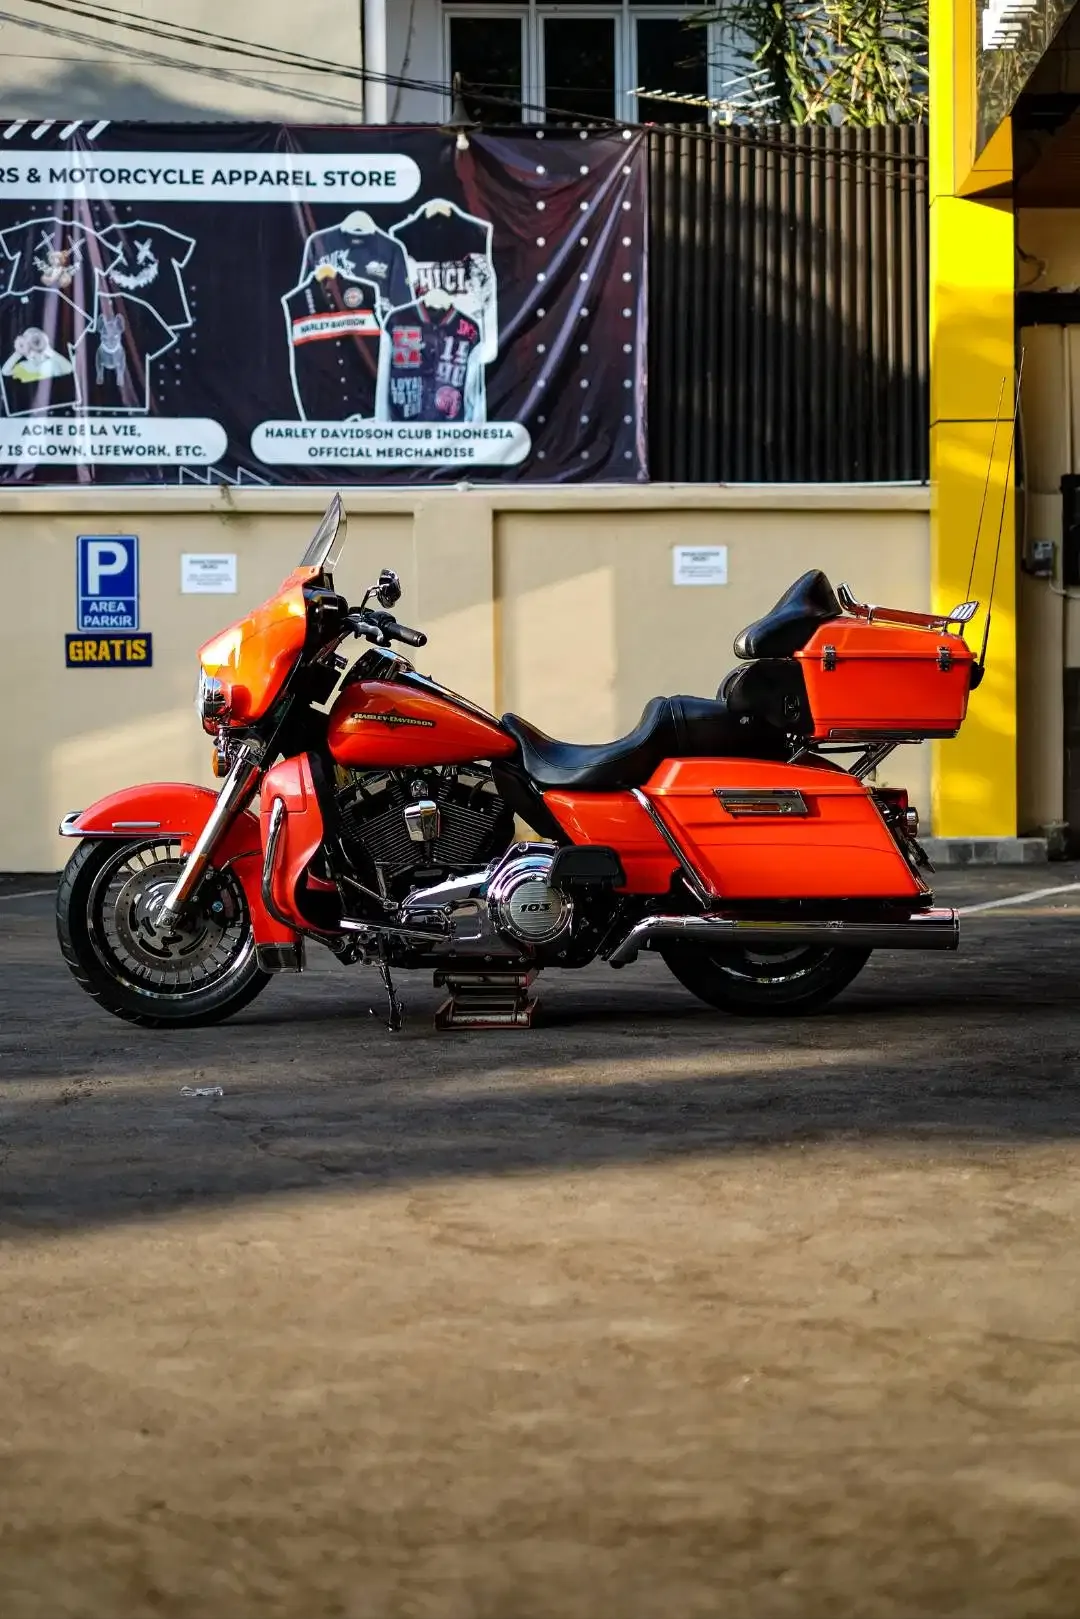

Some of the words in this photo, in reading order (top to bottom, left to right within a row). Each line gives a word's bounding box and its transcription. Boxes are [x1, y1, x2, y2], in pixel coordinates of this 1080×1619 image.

[26, 168, 41, 183] &
[49, 167, 204, 185] MOTORCYCLE
[211, 169, 317, 186] APPAREL
[323, 170, 396, 187] STORE
[22, 424, 63, 436] ACME
[68, 424, 85, 436] DE
[90, 424, 108, 436] LA
[112, 424, 141, 437] VIE,
[265, 428, 316, 438] HARLEY
[321, 428, 393, 439] DAVIDSON
[398, 429, 432, 439] CLUB
[437, 429, 513, 439] INDONESIA
[8, 444, 22, 456] IS
[175, 445, 206, 457] ETC.
[308, 447, 372, 457] OFFICIAL
[377, 447, 474, 457] MERCHANDISE
[87, 541, 128, 595] P
[89, 602, 126, 612] AREA
[83, 616, 132, 627] PARKIR
[69, 640, 146, 661] GRATIS
